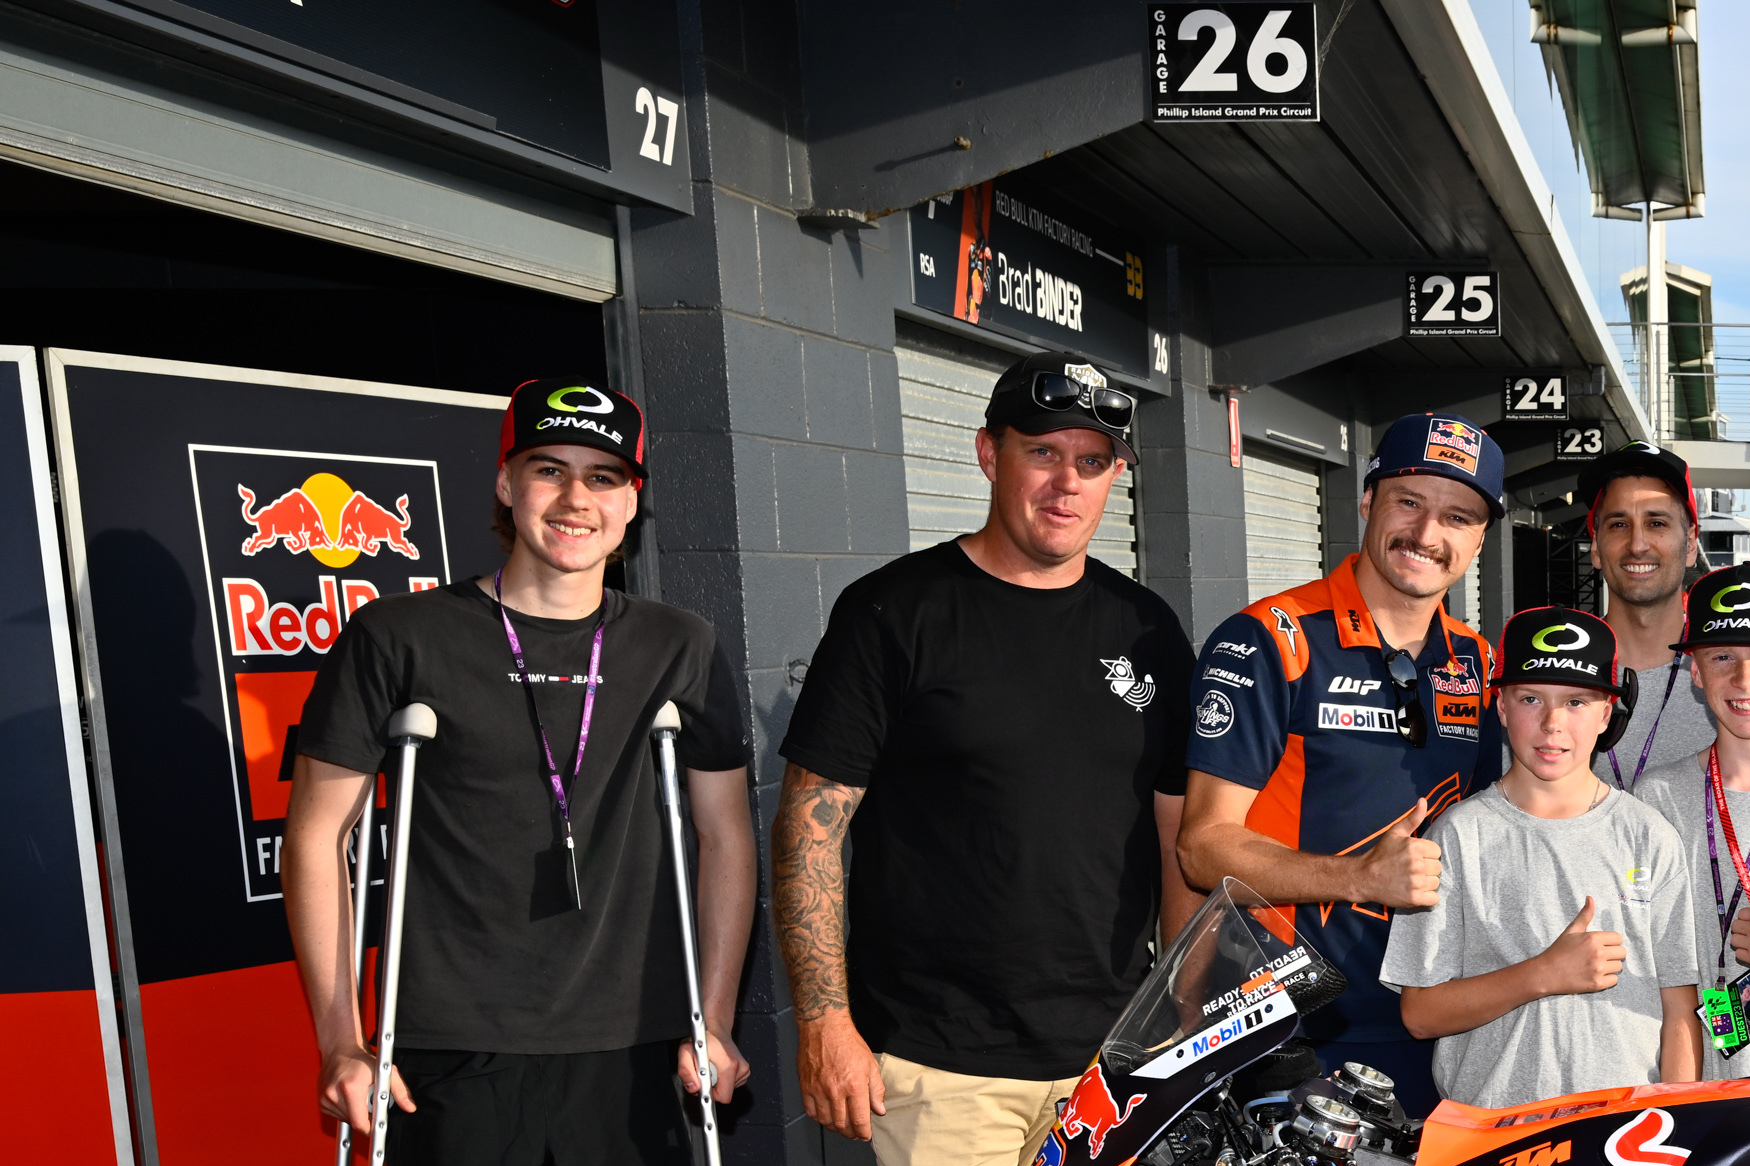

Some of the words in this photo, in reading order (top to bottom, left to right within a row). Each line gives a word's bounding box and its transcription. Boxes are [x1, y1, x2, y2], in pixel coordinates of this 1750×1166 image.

[1154, 10, 1169, 93] GARAGE
[1177, 9, 1308, 93] 26
[1157, 107, 1188, 118] Phillip
[1191, 107, 1222, 117] Island
[1224, 107, 1257, 117] Grand
[1259, 107, 1279, 117] Prix
[1281, 106, 1312, 117] Circuit
[635, 86, 679, 166] 27
[995, 189, 1009, 218] RED
[1011, 197, 1028, 228] BULL
[1029, 205, 1043, 236] KTM
[1044, 213, 1071, 248] FACTORY
[1072, 230, 1094, 258] RACING
[919, 252, 936, 278] RSA
[1125, 251, 1143, 300] 33
[998, 252, 1032, 315] Brad
[1035, 266, 1083, 332] BINDER
[1408, 276, 1417, 322] GARAGE
[1421, 275, 1494, 322] 25
[1410, 328, 1428, 336] Phillip
[1153, 332, 1169, 375] 26
[1514, 378, 1566, 410] 24
[536, 416, 623, 445] OHVALE
[1563, 428, 1603, 453] 23
[1438, 449, 1466, 464] KTM
[1348, 609, 1361, 632] KTM
[516, 658, 524, 669] 23
[1522, 657, 1599, 676] OHVALE
[508, 673, 546, 683] TOMY
[572, 674, 604, 684] JEAS
[1321, 704, 1376, 729] Mobil
[1442, 702, 1477, 720] KTM
[1439, 725, 1465, 736] FACTORY
[1284, 972, 1306, 987] RACE
[1202, 986, 1242, 1016] READY
[1192, 1018, 1243, 1057] Mobil
